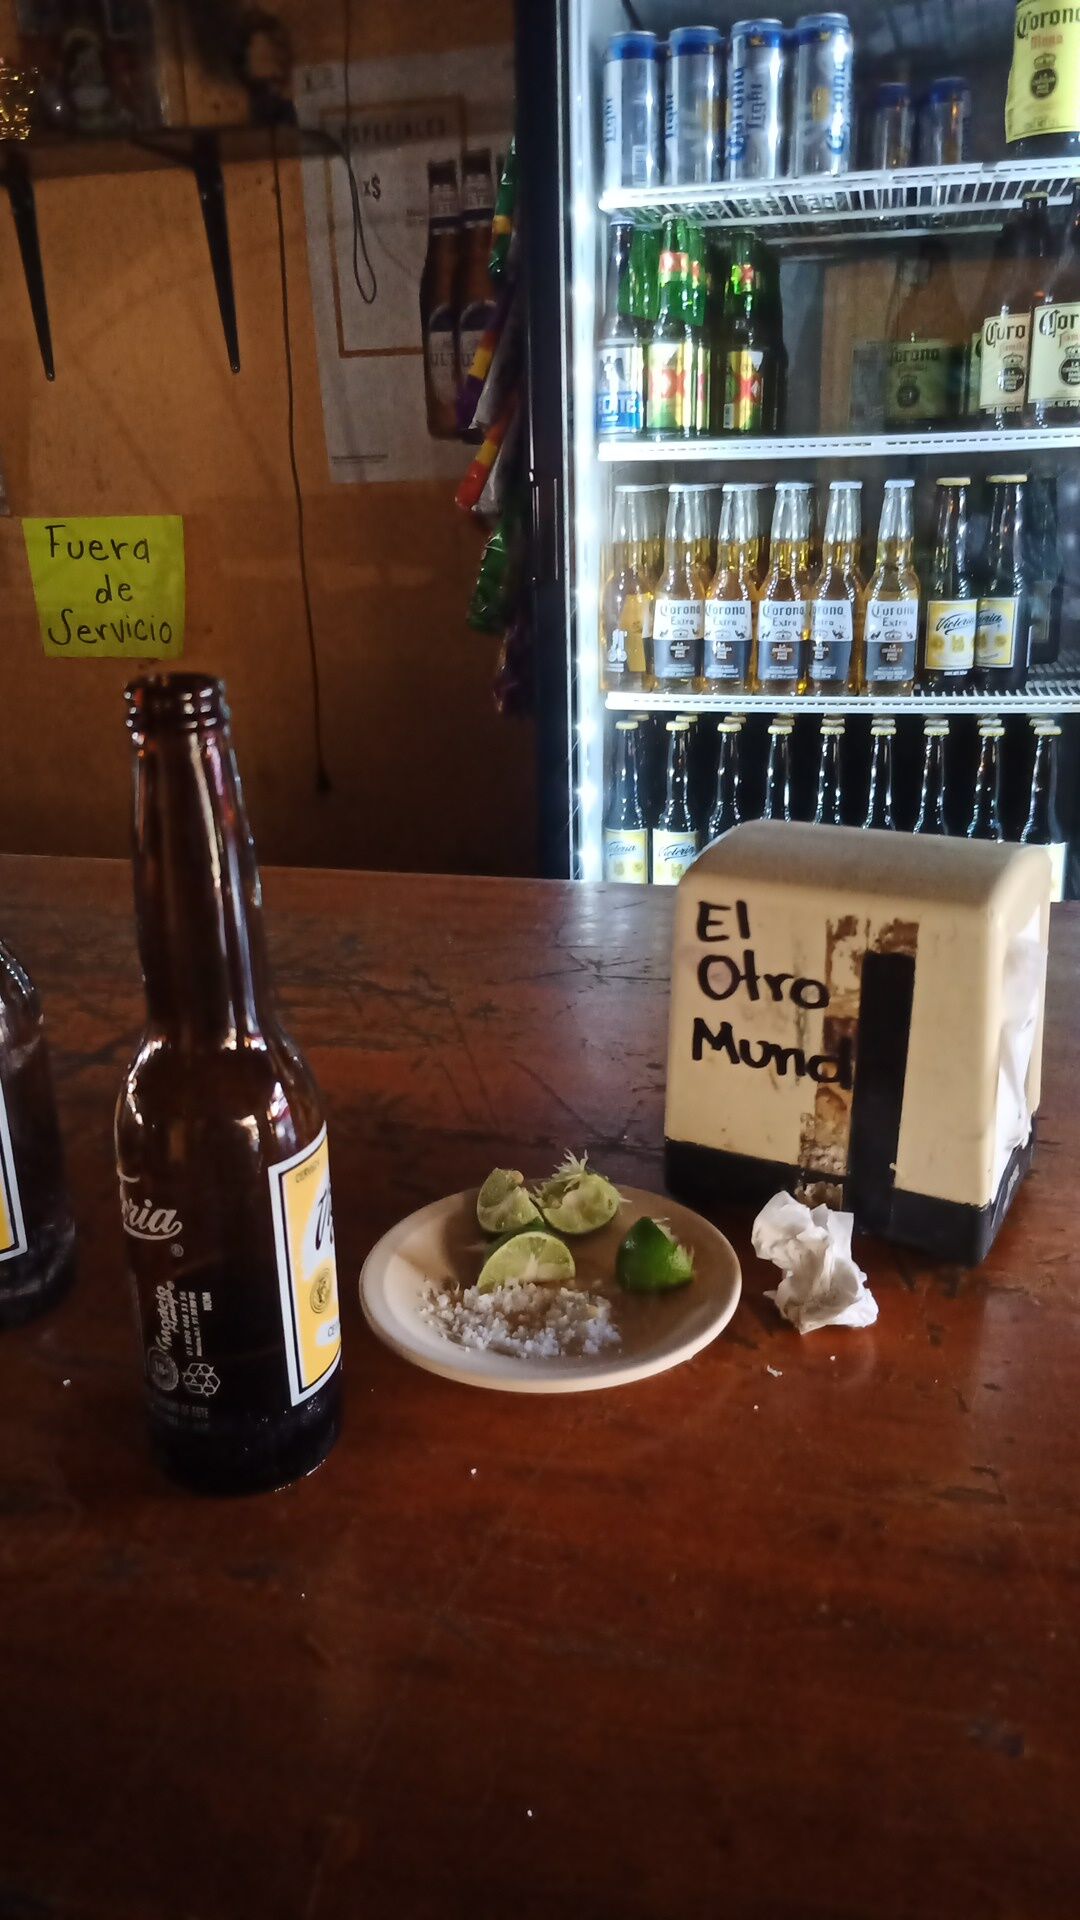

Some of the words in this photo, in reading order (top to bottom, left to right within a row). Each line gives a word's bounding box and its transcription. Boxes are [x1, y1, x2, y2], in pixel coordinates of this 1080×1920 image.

[45, 524, 150, 563] Fuera
[95, 574, 133, 604] de
[48, 608, 172, 645] Servicio
[660, 604, 701, 616] Corona
[763, 604, 804, 618] Corona
[871, 604, 914, 618] Corona
[697, 900, 750, 942] El
[697, 949, 830, 1010] Otro
